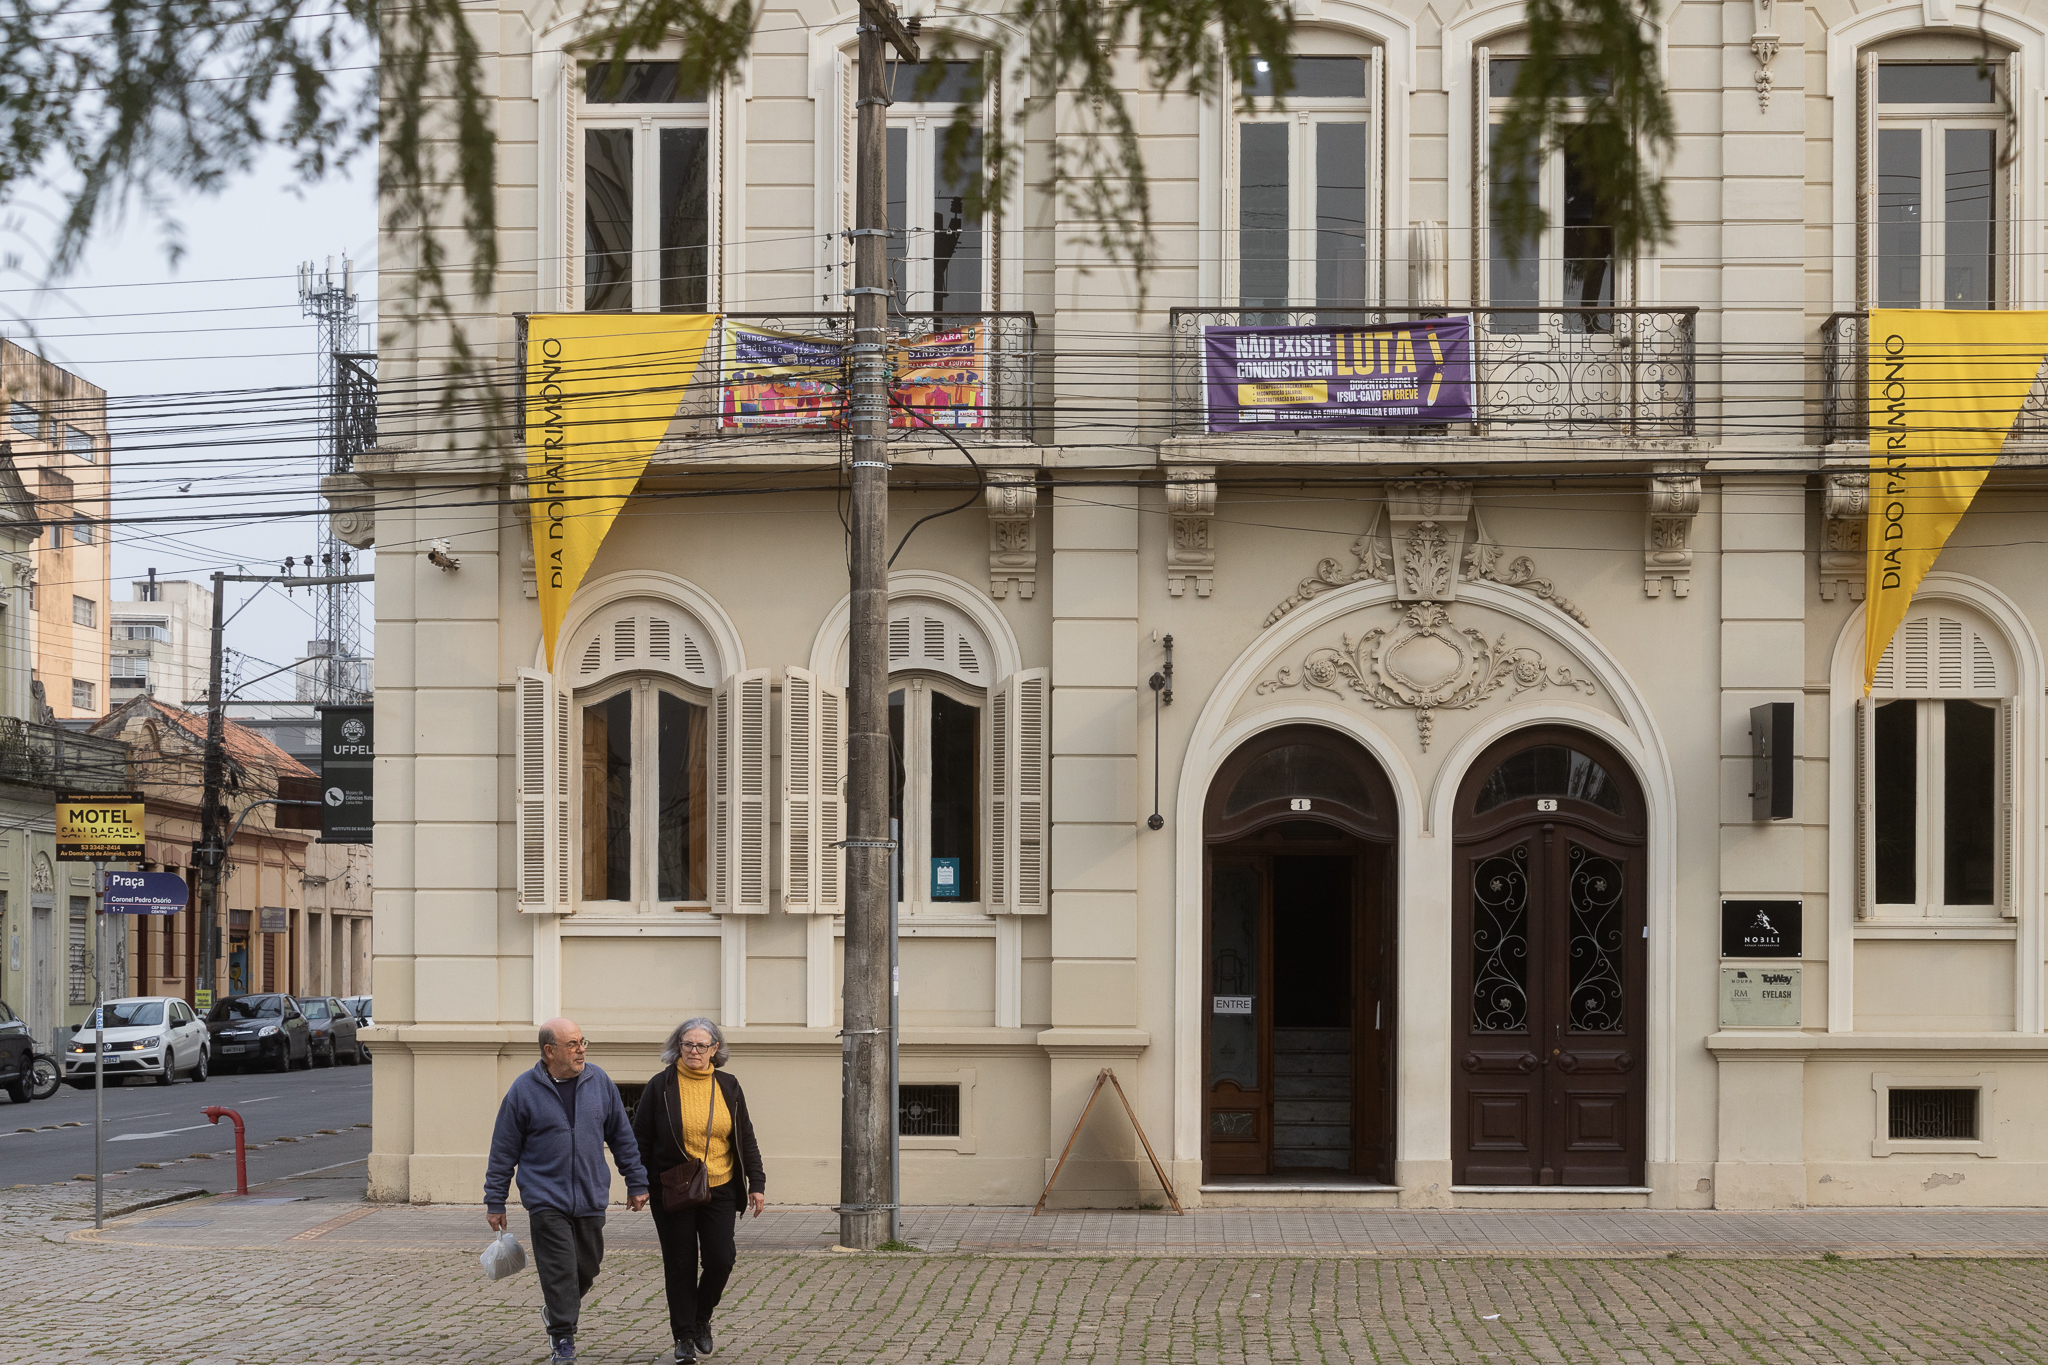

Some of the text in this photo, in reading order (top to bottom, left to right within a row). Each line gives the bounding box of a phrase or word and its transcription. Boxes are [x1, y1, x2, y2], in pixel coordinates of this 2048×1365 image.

[935, 333, 962, 342] PARA
[1236, 333, 1332, 358] NÃO EXISTE
[1336, 331, 1417, 375] LUTA
[1236, 360, 1333, 379] CONQUISTA SEM
[1337, 389, 1419, 402] IFSUL-CAVG EM GREVE
[1383, 407, 1388, 416] E
[1388, 407, 1419, 416] GRATUITA
[539, 338, 564, 589] DIA DO PATRIMÔNIO
[1882, 334, 1906, 590] DIA DO PATRIMÔNIO
[333, 745, 373, 754] UFPEL
[1298, 800, 1303, 809] 1
[1544, 801, 1551, 810] 3
[69, 809, 133, 823] MOTEL
[112, 875, 145, 889] Praça
[152, 896, 172, 904] Osório
[1761, 974, 1793, 985] TopWay
[1762, 990, 1792, 999] EYELASH
[1216, 999, 1250, 1009] ENTRE
